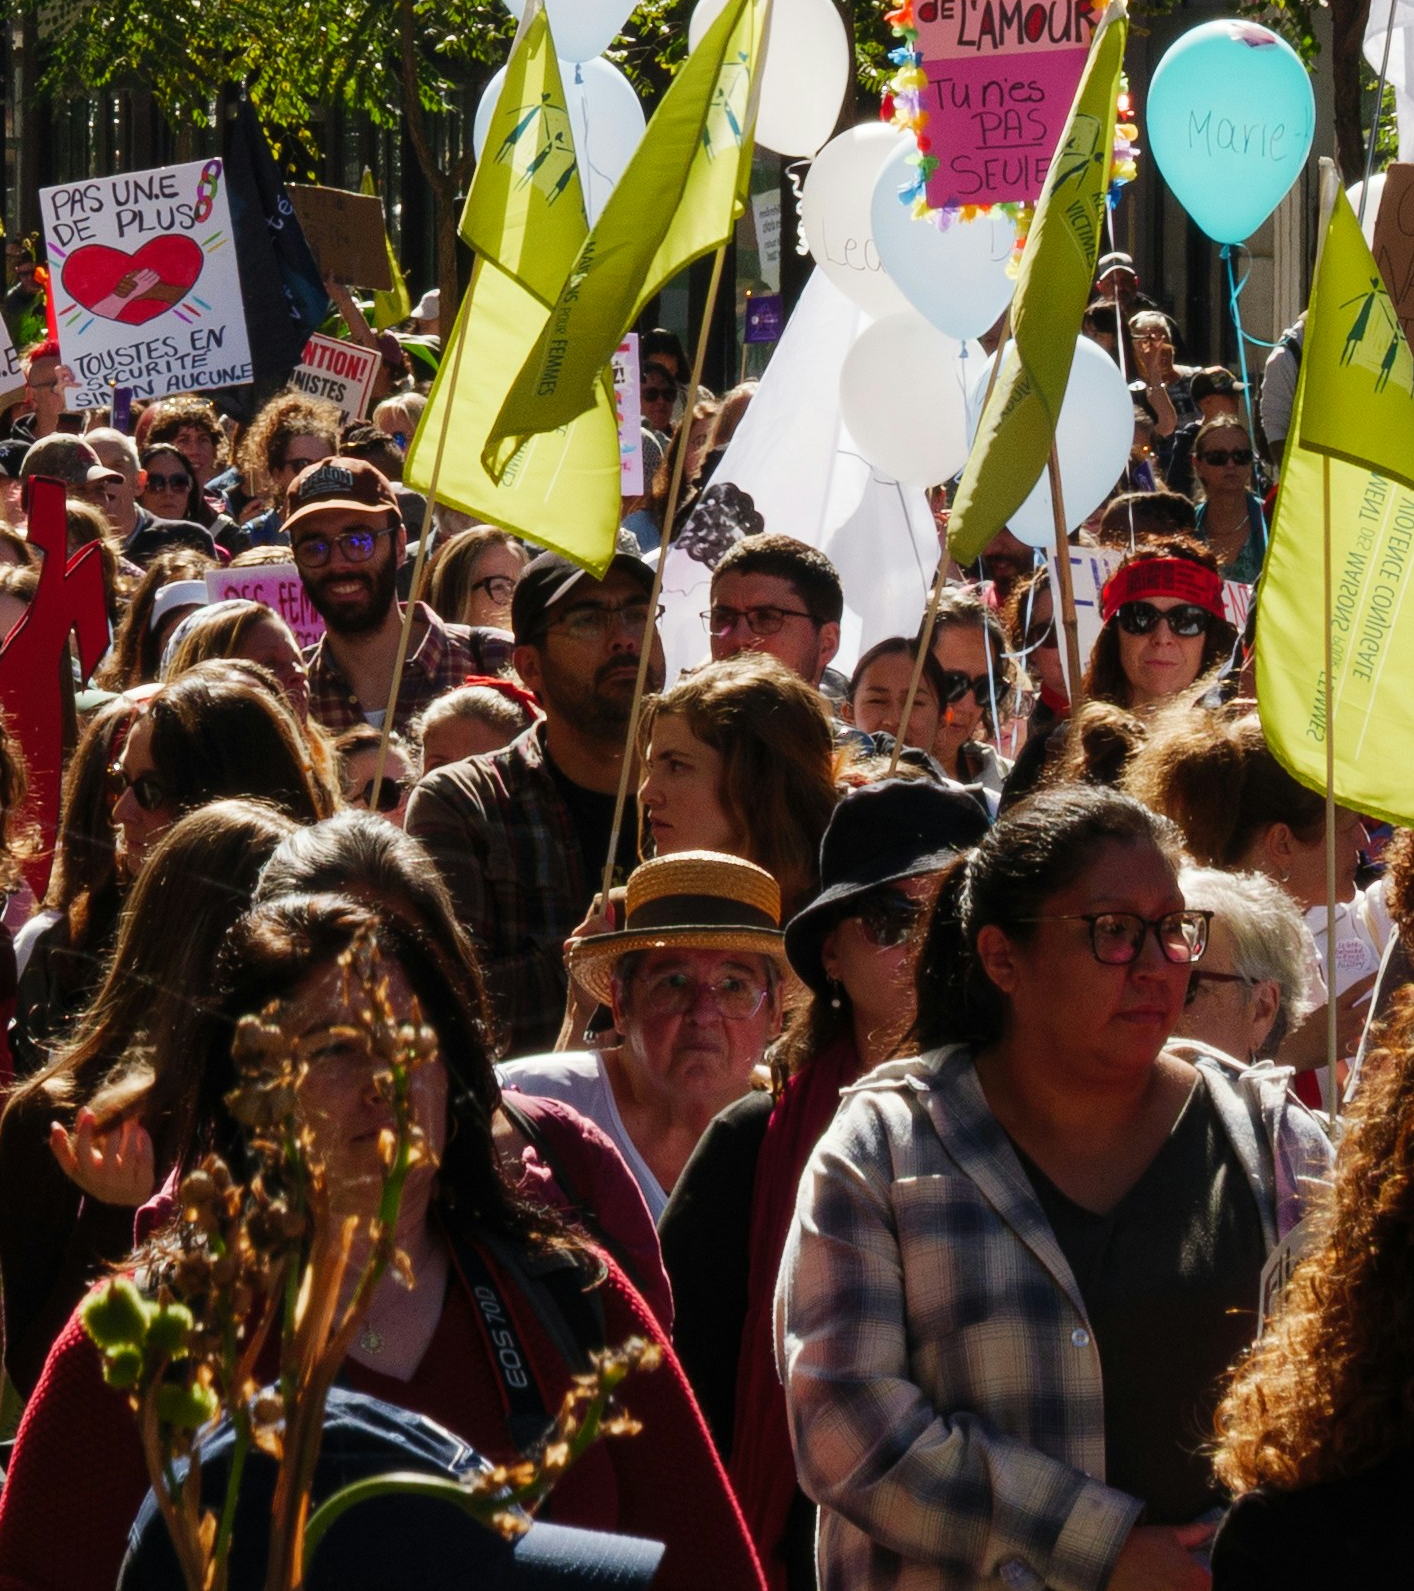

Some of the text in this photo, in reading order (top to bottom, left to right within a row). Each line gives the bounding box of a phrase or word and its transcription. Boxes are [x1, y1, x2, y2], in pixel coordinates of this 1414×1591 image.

[971, 109, 1048, 146] PAS
[51, 184, 104, 221] PAS
[52, 203, 197, 248] DE PLUS
[74, 324, 226, 380] TOUSTES EN
[538, 339, 569, 397] FEMMES
[474, 1286, 528, 1388] EOS 70D
